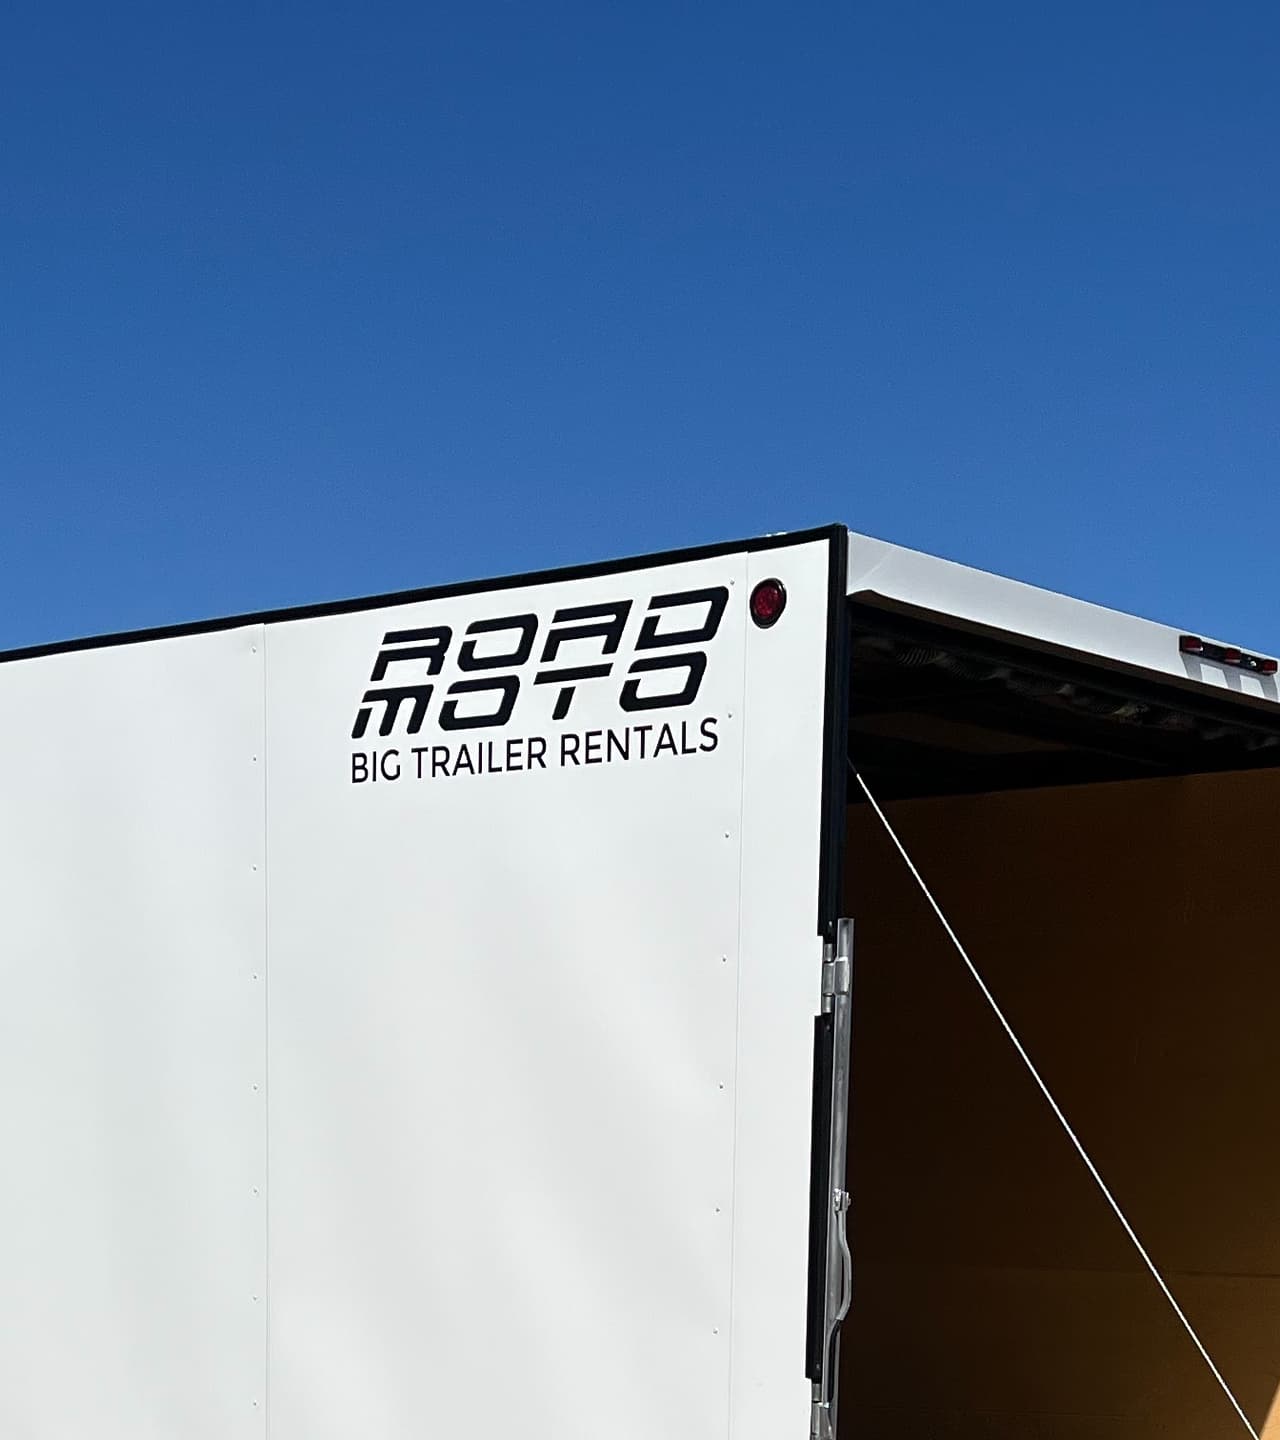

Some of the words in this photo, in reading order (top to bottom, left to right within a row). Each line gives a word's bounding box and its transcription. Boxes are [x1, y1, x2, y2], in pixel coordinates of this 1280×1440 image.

[370, 585, 730, 682] ROAD
[351, 650, 708, 739] MOTO
[351, 749, 401, 784] BIG
[410, 736, 547, 779] TRAILER
[560, 717, 718, 767] RENTALS
